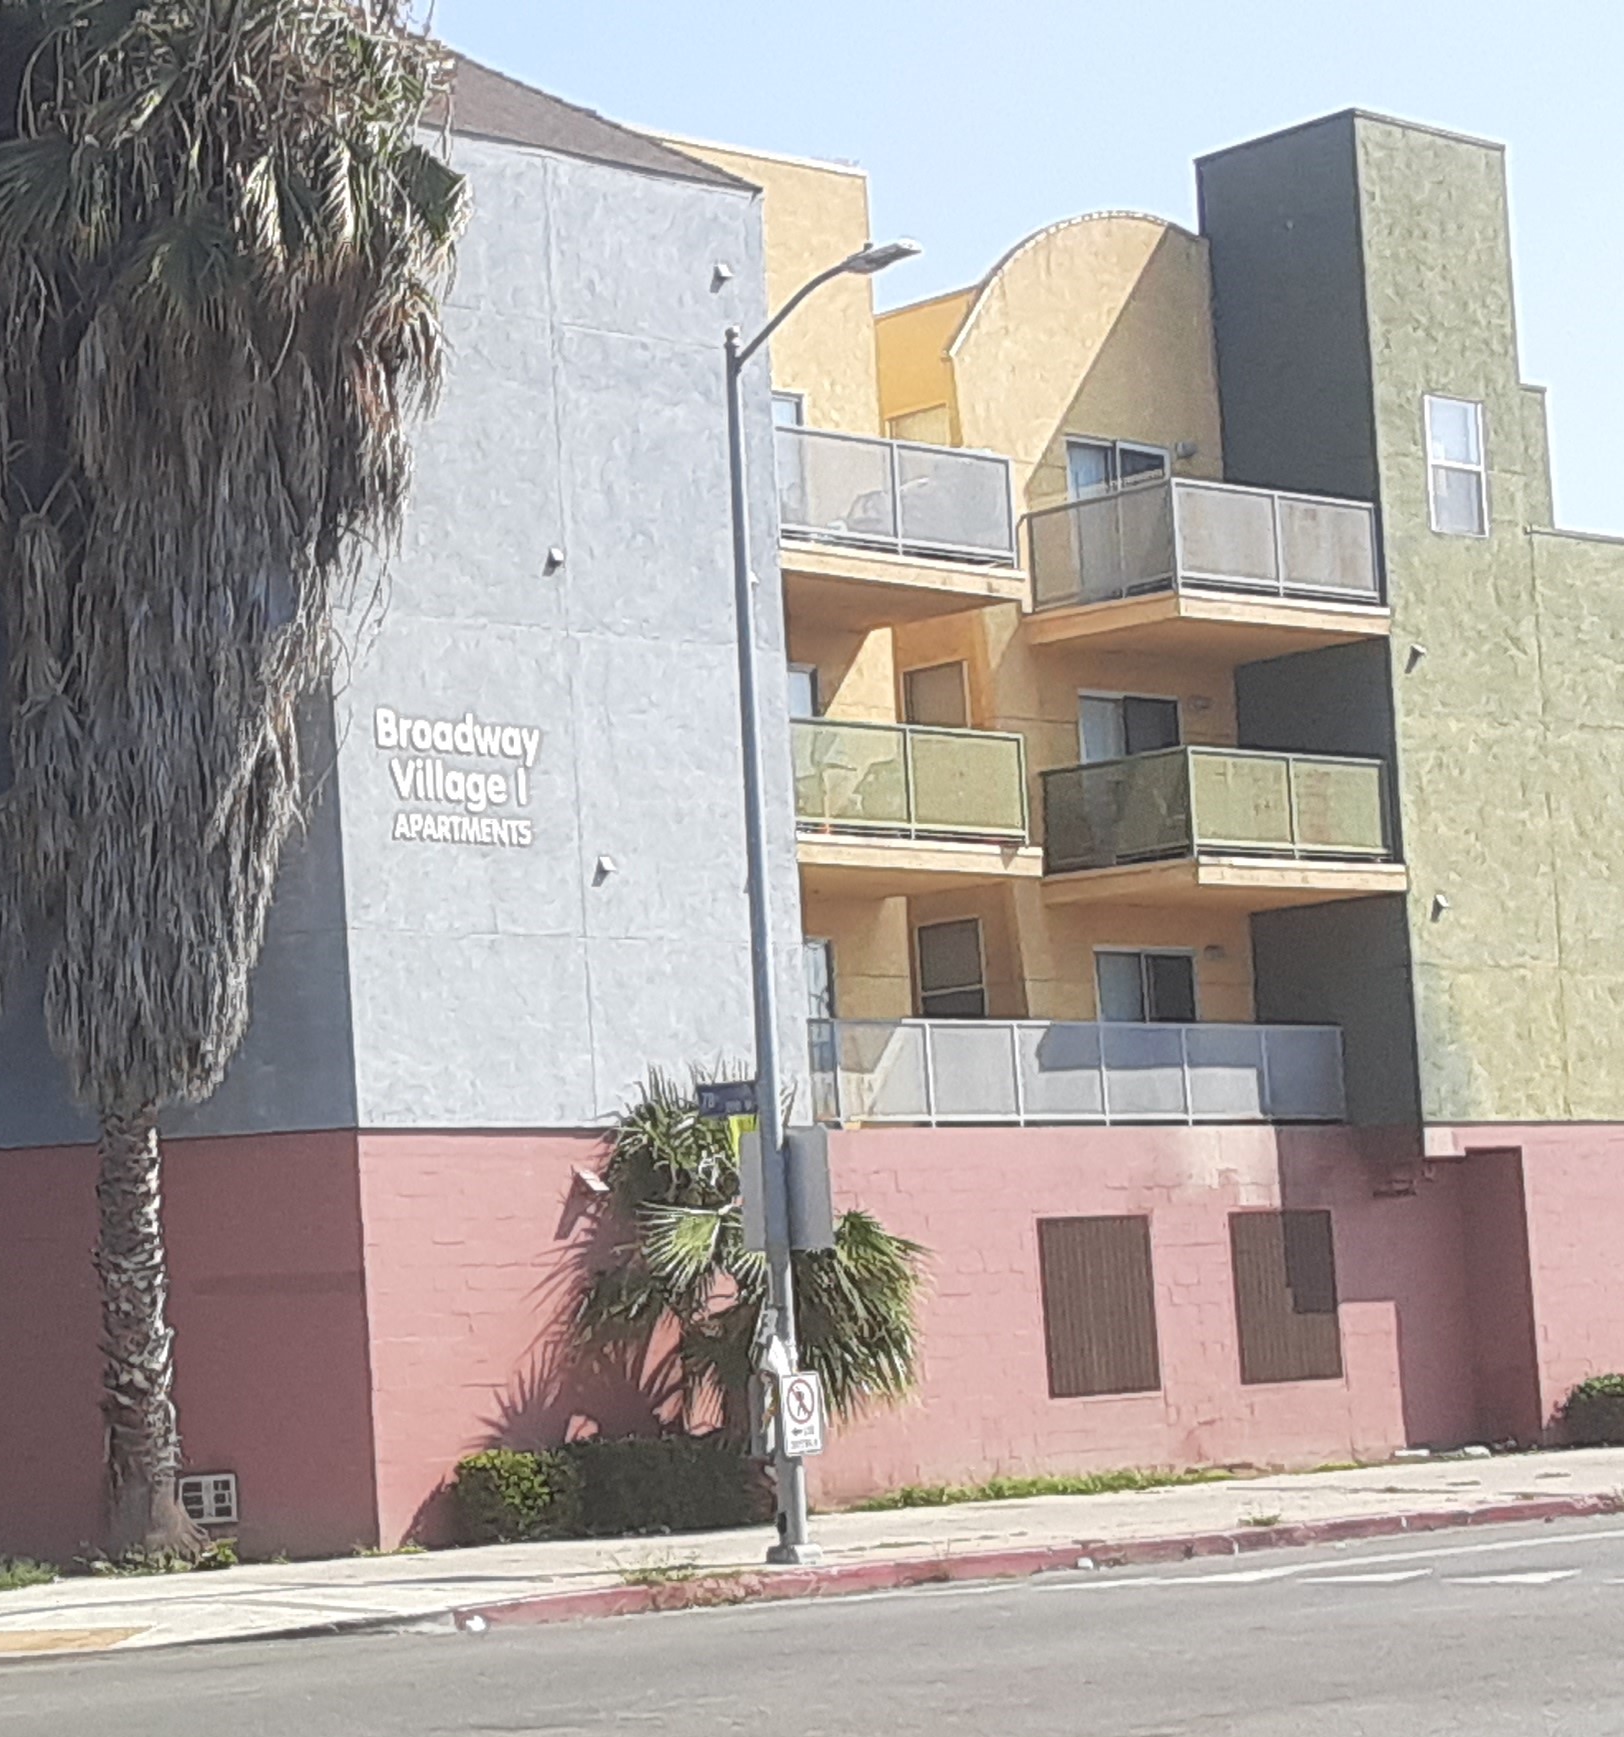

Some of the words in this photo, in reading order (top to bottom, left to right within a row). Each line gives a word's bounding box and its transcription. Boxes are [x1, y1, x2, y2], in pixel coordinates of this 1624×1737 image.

[375, 706, 540, 767] Broadway
[390, 757, 508, 812] Village
[393, 812, 532, 846] APARTMENTS
